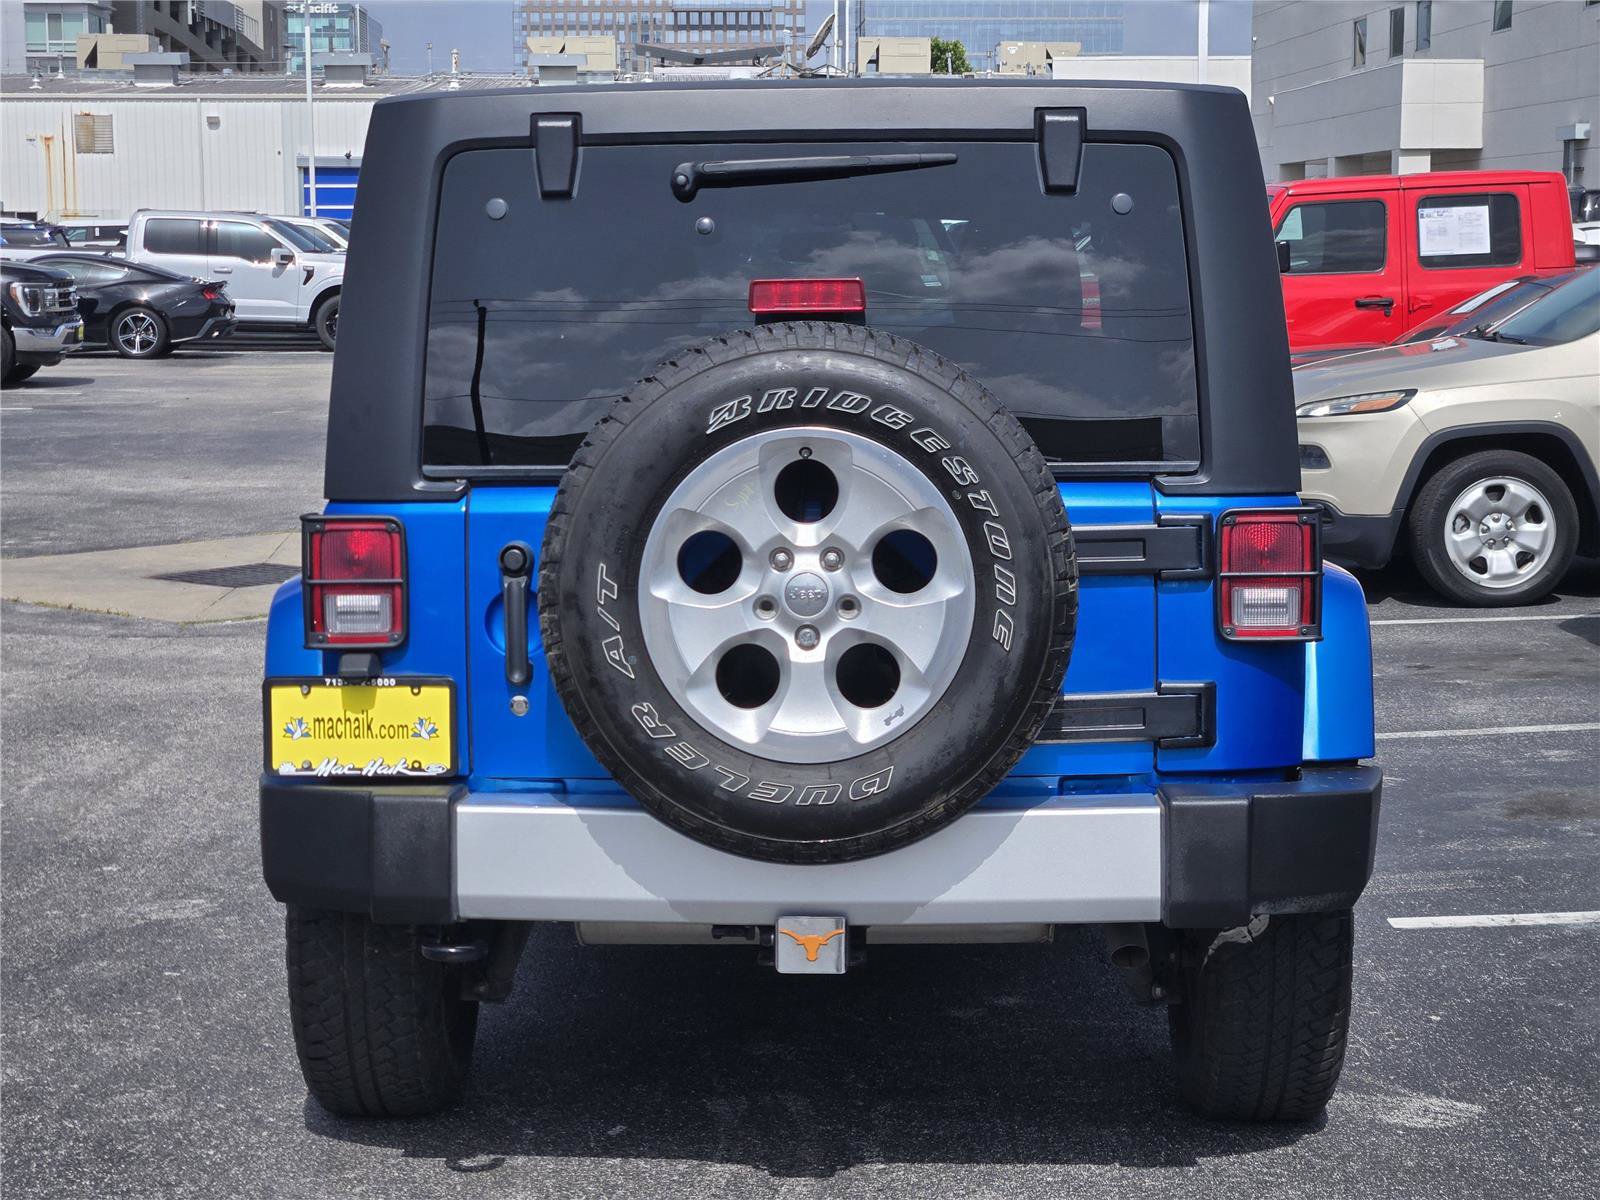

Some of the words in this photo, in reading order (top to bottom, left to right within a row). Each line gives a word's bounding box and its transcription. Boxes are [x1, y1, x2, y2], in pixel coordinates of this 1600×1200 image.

[705, 386, 1017, 652] BRIDGESTONE
[597, 562, 636, 680] A/T
[313, 709, 410, 740] machaik.com
[314, 757, 358, 778] Mac
[361, 757, 409, 777] Haik
[631, 702, 895, 806] DUELER
